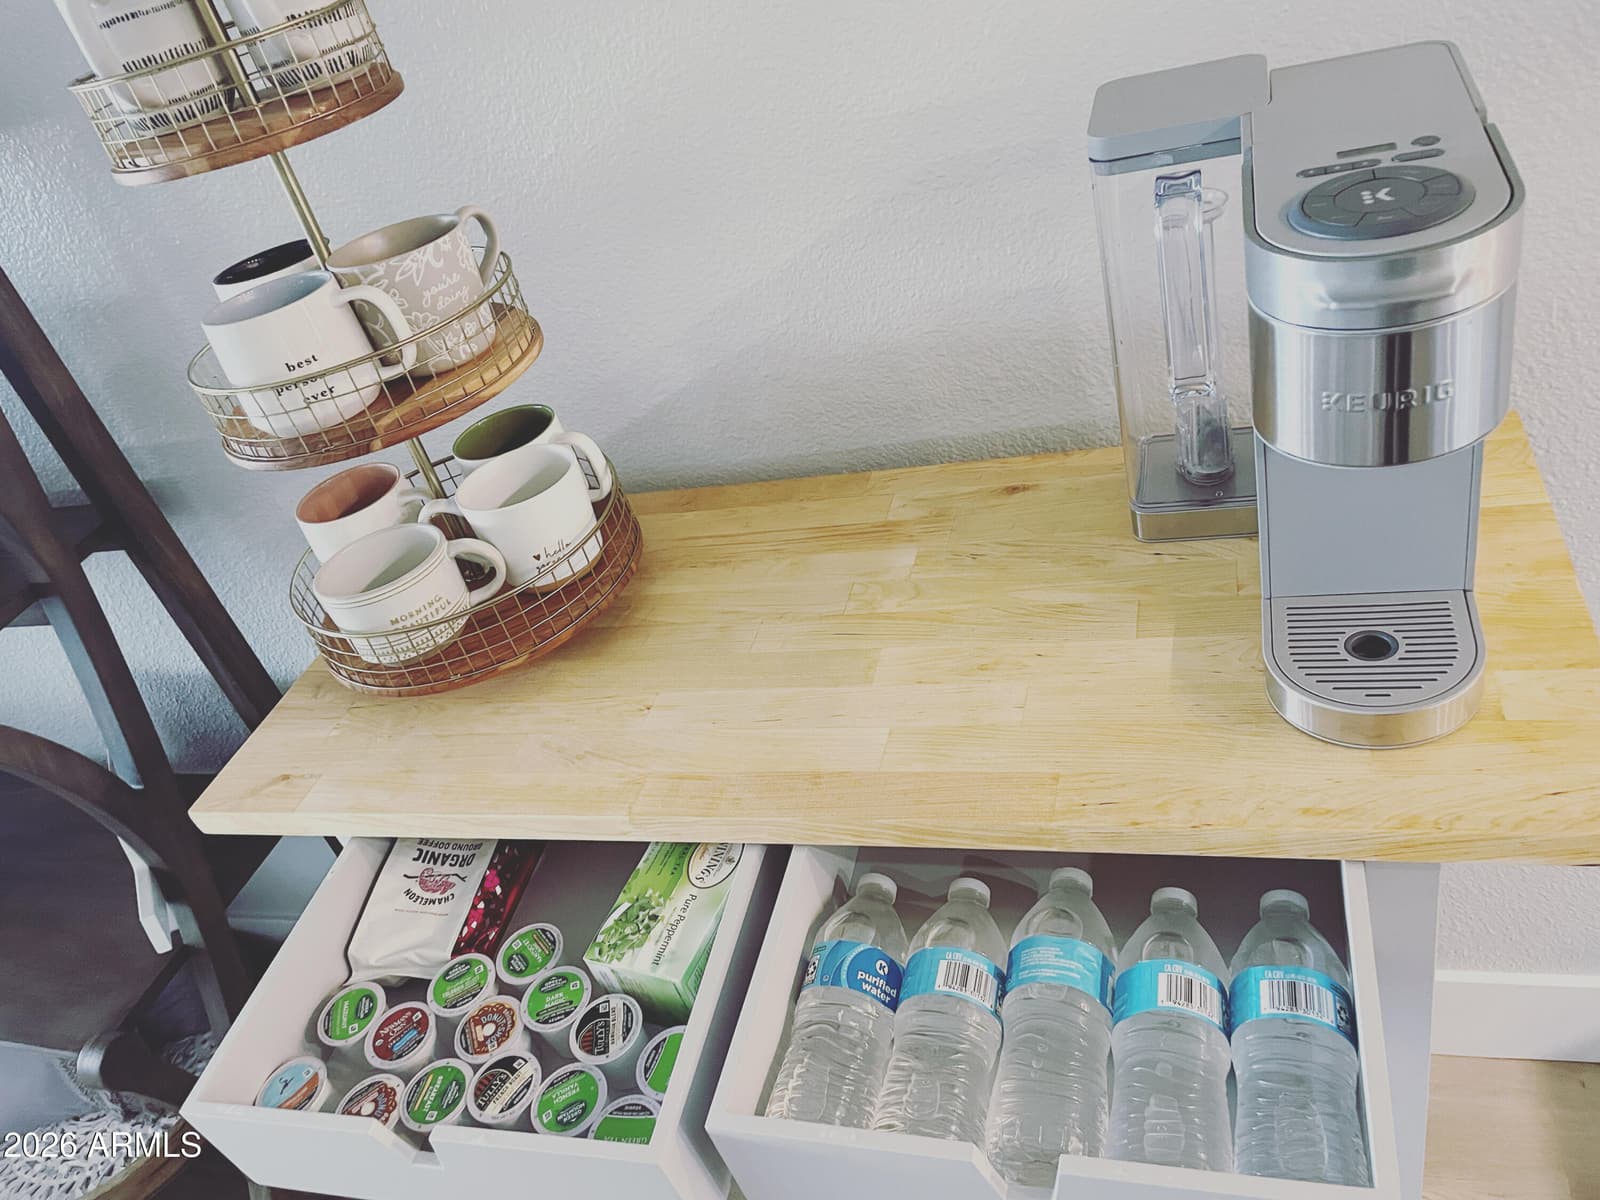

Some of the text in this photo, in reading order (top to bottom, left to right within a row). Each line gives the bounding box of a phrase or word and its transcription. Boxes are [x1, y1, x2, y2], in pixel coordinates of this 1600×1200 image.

[284, 354, 319, 373] best
[1320, 378, 1455, 413] KEURIG
[544, 538, 572, 558] hello
[390, 594, 443, 625] MORNING
[412, 847, 477, 868] ORGANIC
[403, 887, 455, 906] CHAMELEON
[651, 894, 698, 966] Pure Peppermint
[857, 970, 897, 998] purified
[862, 982, 891, 1003] water
[545, 992, 564, 1002] DARK
[480, 1013, 506, 1026] DONUT
[595, 1021, 606, 1056] TULLY'S
[477, 1072, 507, 1106] TULLY'S
[552, 1082, 578, 1099] VANILLA
[553, 1086, 580, 1104] FRENCH
